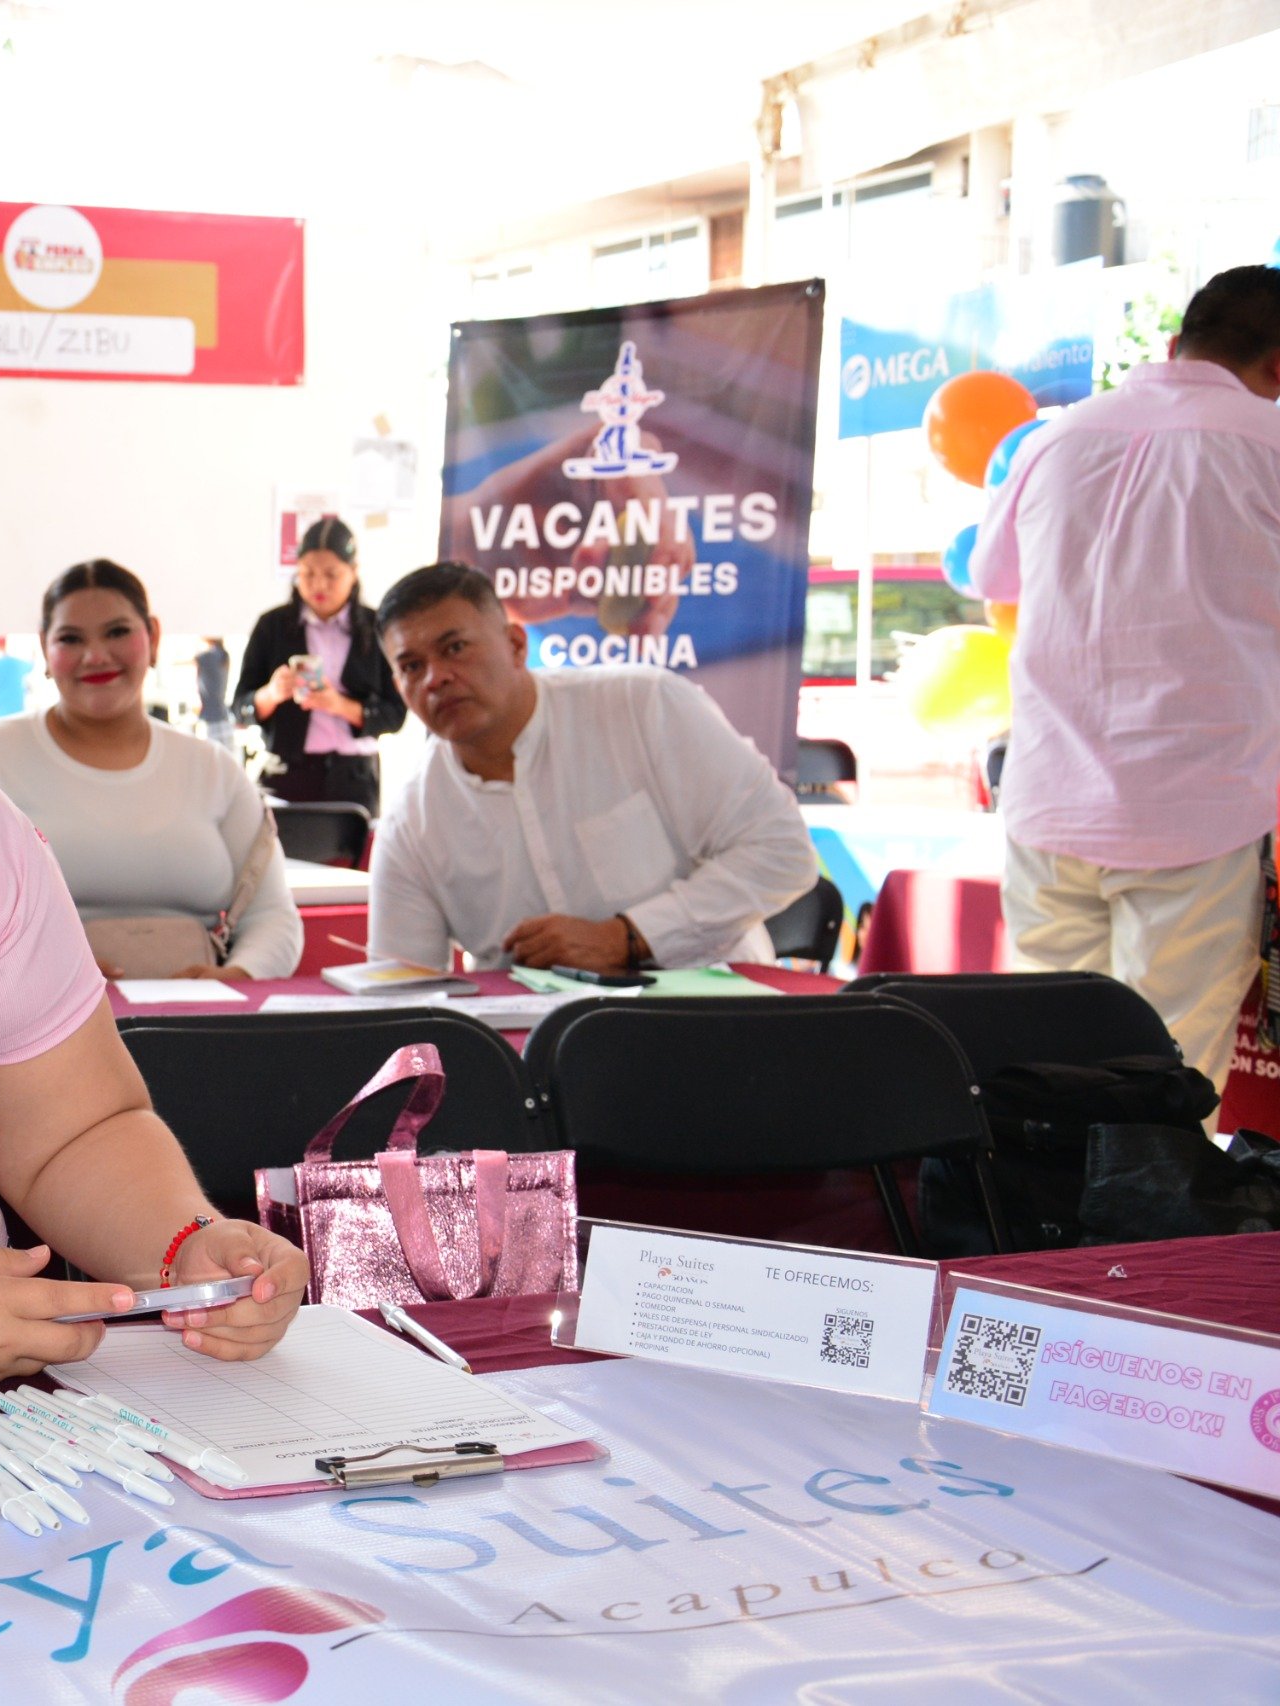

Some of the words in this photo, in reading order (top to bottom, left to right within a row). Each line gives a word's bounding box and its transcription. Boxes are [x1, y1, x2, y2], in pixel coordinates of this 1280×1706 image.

[871, 346, 951, 388] MEGA
[470, 492, 778, 551] VACANTES
[494, 563, 738, 599] DISPONIBLES
[539, 633, 698, 670] COCINA
[640, 1250, 672, 1268] Playa
[677, 1255, 715, 1271] Suites
[644, 1282, 694, 1295] CAPACITACION
[765, 1267, 780, 1280] TE
[784, 1269, 874, 1293] OFRECEMOS:
[641, 1302, 676, 1312] COMEDOR
[642, 1292, 661, 1301] PAGO
[663, 1295, 703, 1307] QUINCENAL
[712, 1302, 745, 1313] SEMANAL
[637, 1321, 687, 1335] PRESTACIONES
[639, 1312, 659, 1321] VALES
[661, 1314, 670, 1322] DE
[672, 1316, 707, 1328] DESPENSA
[713, 1322, 749, 1334] PERSONAL
[751, 1328, 809, 1344] SINDICALIZADO)
[635, 1341, 669, 1353] PROPINAS
[636, 1331, 652, 1341] CAJA
[659, 1334, 684, 1344] FONDO
[686, 1339, 698, 1347] DE
[698, 1341, 727, 1352] AHORRO
[729, 1346, 771, 1360] (OPCIONAL)
[1040, 1339, 1204, 1390] ¡SÍGUENOS
[1207, 1371, 1252, 1401] EN
[1049, 1380, 1225, 1438] FACEBOOK!
[348, 1441, 393, 1451] SUITES
[394, 1436, 437, 1447] PLAYA
[439, 1431, 481, 1440] HOTEL
[275, 1447, 346, 1459] ACAPULCO
[328, 1451, 1016, 1576] Suites
[509, 1546, 1026, 1629] Acapulco
